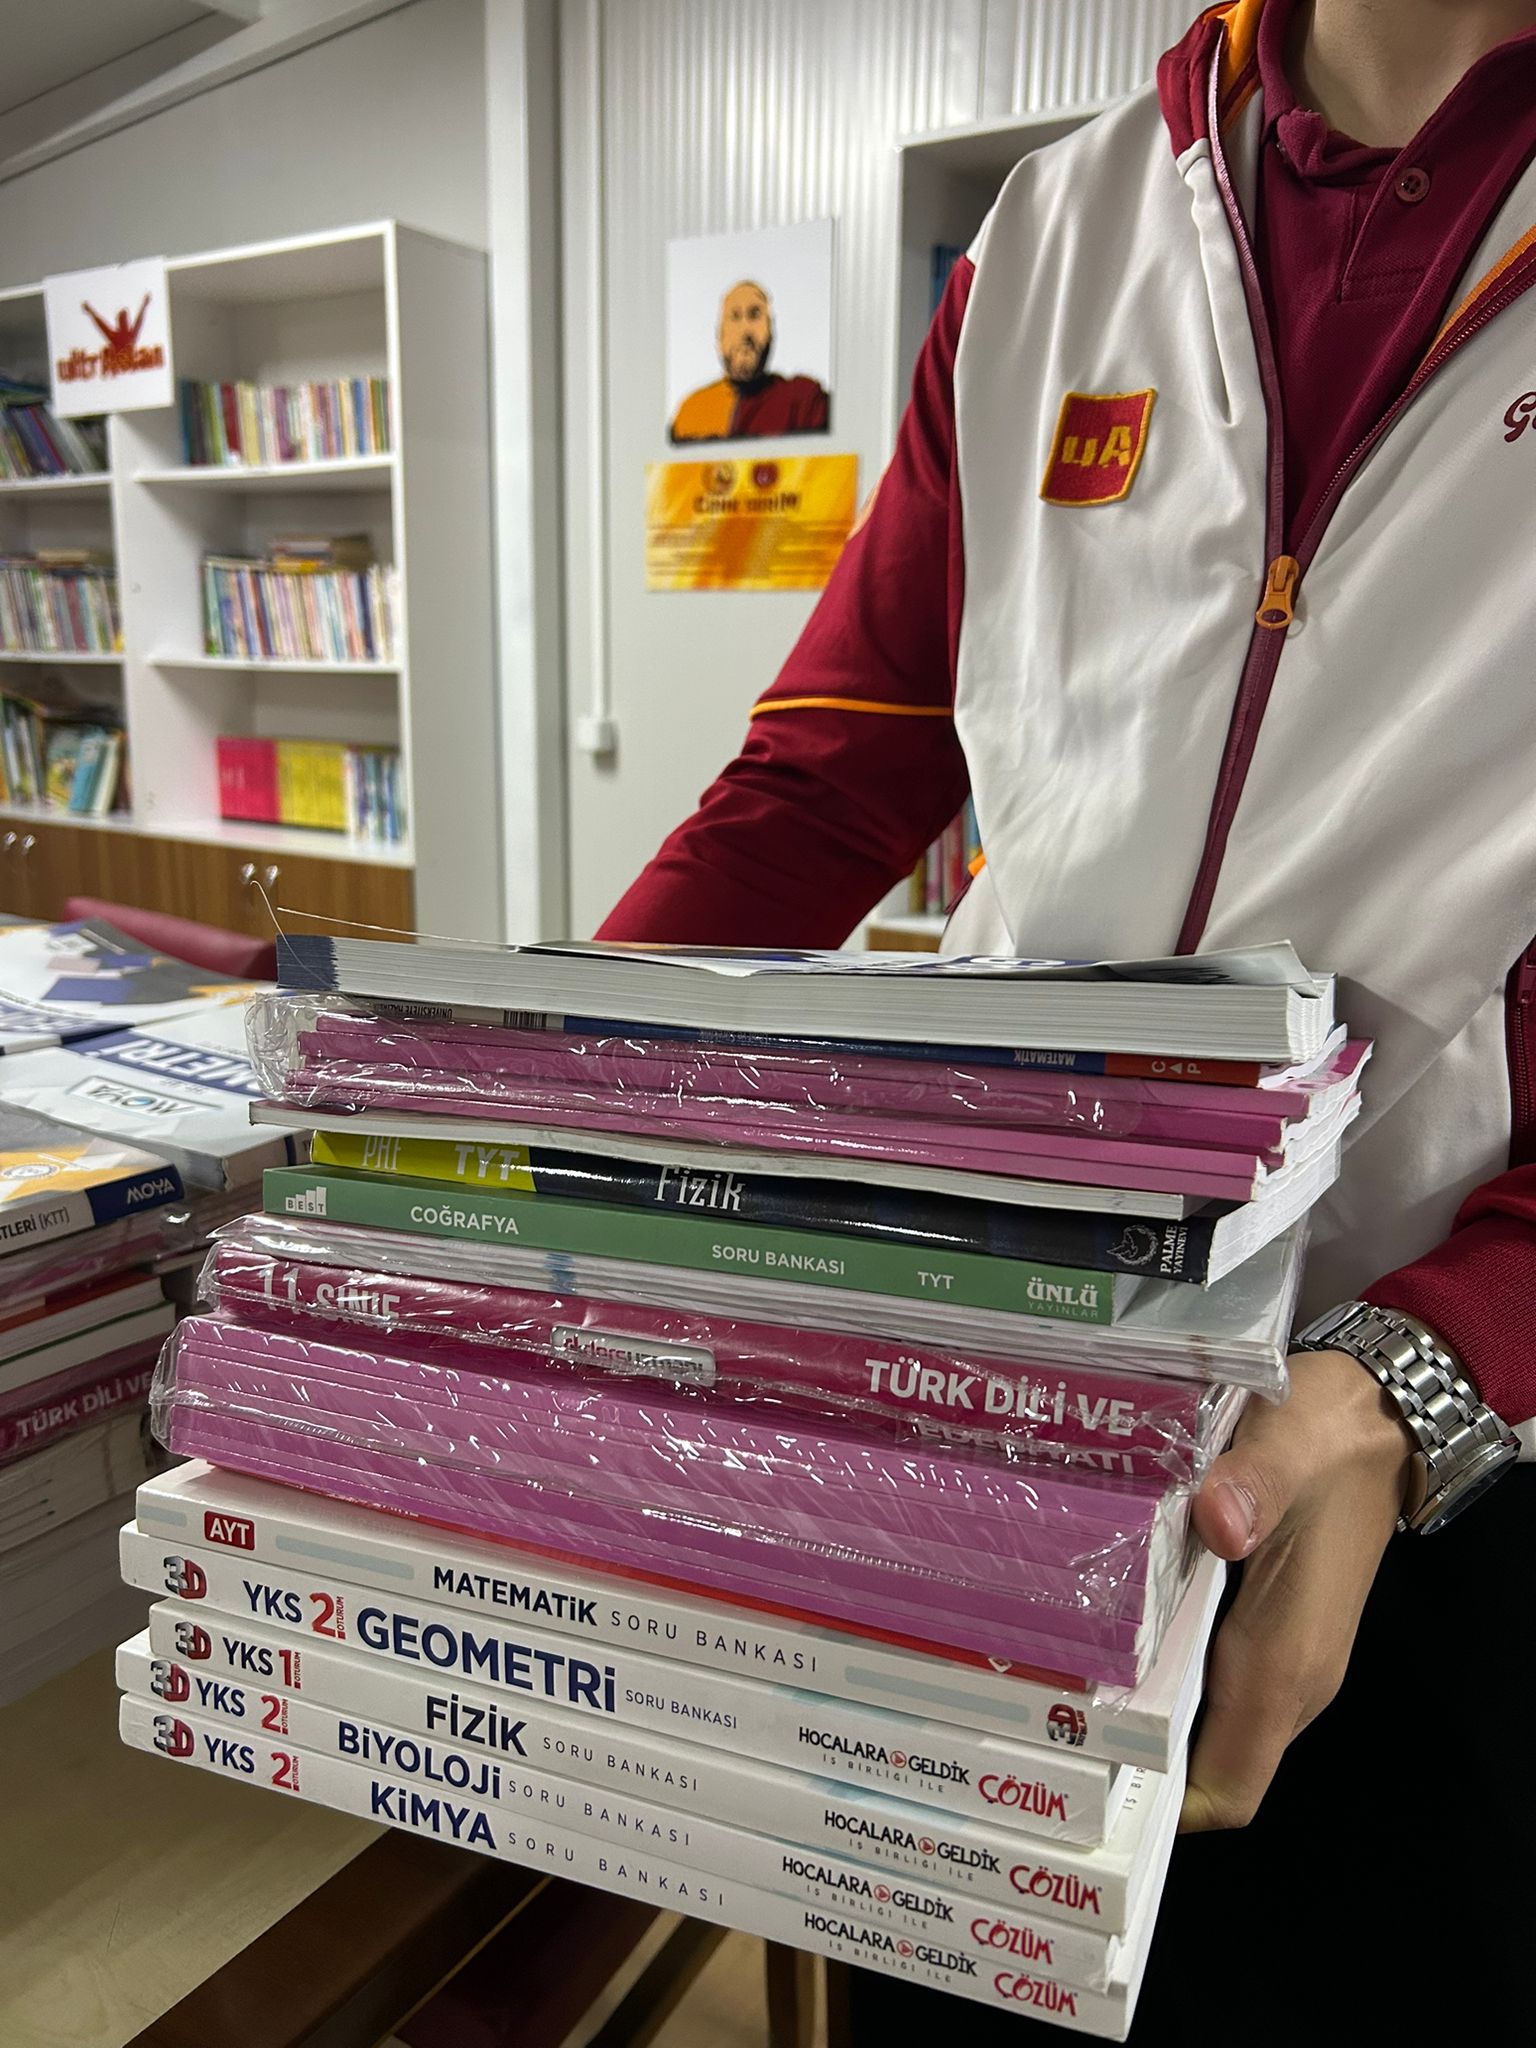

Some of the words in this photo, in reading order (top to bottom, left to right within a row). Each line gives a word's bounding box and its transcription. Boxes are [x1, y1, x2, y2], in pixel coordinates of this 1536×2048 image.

[127, 1177, 175, 1204] MOYA
[455, 1144, 520, 1181] TYT
[287, 1199, 325, 1213] BEST
[410, 1204, 519, 1235] COĞRAFYA
[712, 1245, 760, 1263] SORU
[765, 1251, 845, 1275] BANKASI
[917, 1271, 954, 1290] TYT
[1026, 1277, 1099, 1308] ÜNLÜ
[1160, 1225, 1178, 1273] PALME
[16, 1400, 79, 1438] TÜRK
[82, 1378, 123, 1414] DİLİ
[865, 1356, 975, 1410] TÜRK
[984, 1374, 1067, 1425] DİLİ
[1076, 1393, 1135, 1437] VE
[163, 1555, 207, 1600] 3D
[242, 1579, 303, 1624] YKS
[335, 1595, 345, 1632] OTURUM
[356, 1606, 615, 1713] GEOMETRİ
[625, 1689, 665, 1710] SORU
[671, 1700, 737, 1729] BANKASI
[209, 1517, 250, 1546] AYT
[433, 1565, 598, 1626] MATEMATİK
[611, 1610, 677, 1640] SORU
[696, 1630, 816, 1673] BANKASI
[150, 1659, 190, 1703] 3D
[195, 1677, 246, 1718] YKS
[338, 1720, 501, 1800] BİYOLOJİ
[509, 1780, 565, 1808] SORU
[584, 1803, 689, 1846] BANKASI
[174, 1621, 212, 1661] 3D
[222, 1636, 273, 1676] YKS
[426, 1693, 528, 1757] FİZİK
[543, 1736, 593, 1762] SORU
[607, 1754, 697, 1792] BANKASI
[153, 1714, 195, 1757] 3D
[203, 1734, 255, 1774] YKS
[371, 1780, 498, 1850] KİMYA
[508, 1832, 574, 1862] SORU
[599, 1858, 723, 1906] BANKASI
[799, 1726, 888, 1765] HOCALARA
[908, 1755, 971, 1786] GELDİK
[978, 1773, 1067, 1822] ÇÖZÜM
[782, 1855, 873, 1899] HOCALARA
[892, 1890, 955, 1923] GELDİK
[970, 1918, 1053, 1965] ÇÖZÜM
[825, 1809, 917, 1851] HOCALARA
[937, 1842, 1001, 1874] GELDİK
[1009, 1864, 1101, 1915] ÇÖZÜM
[804, 1911, 895, 1954] HOCALARA
[915, 1945, 978, 1978] GELDİK
[993, 1972, 1077, 2017] ÇÖZÜM
